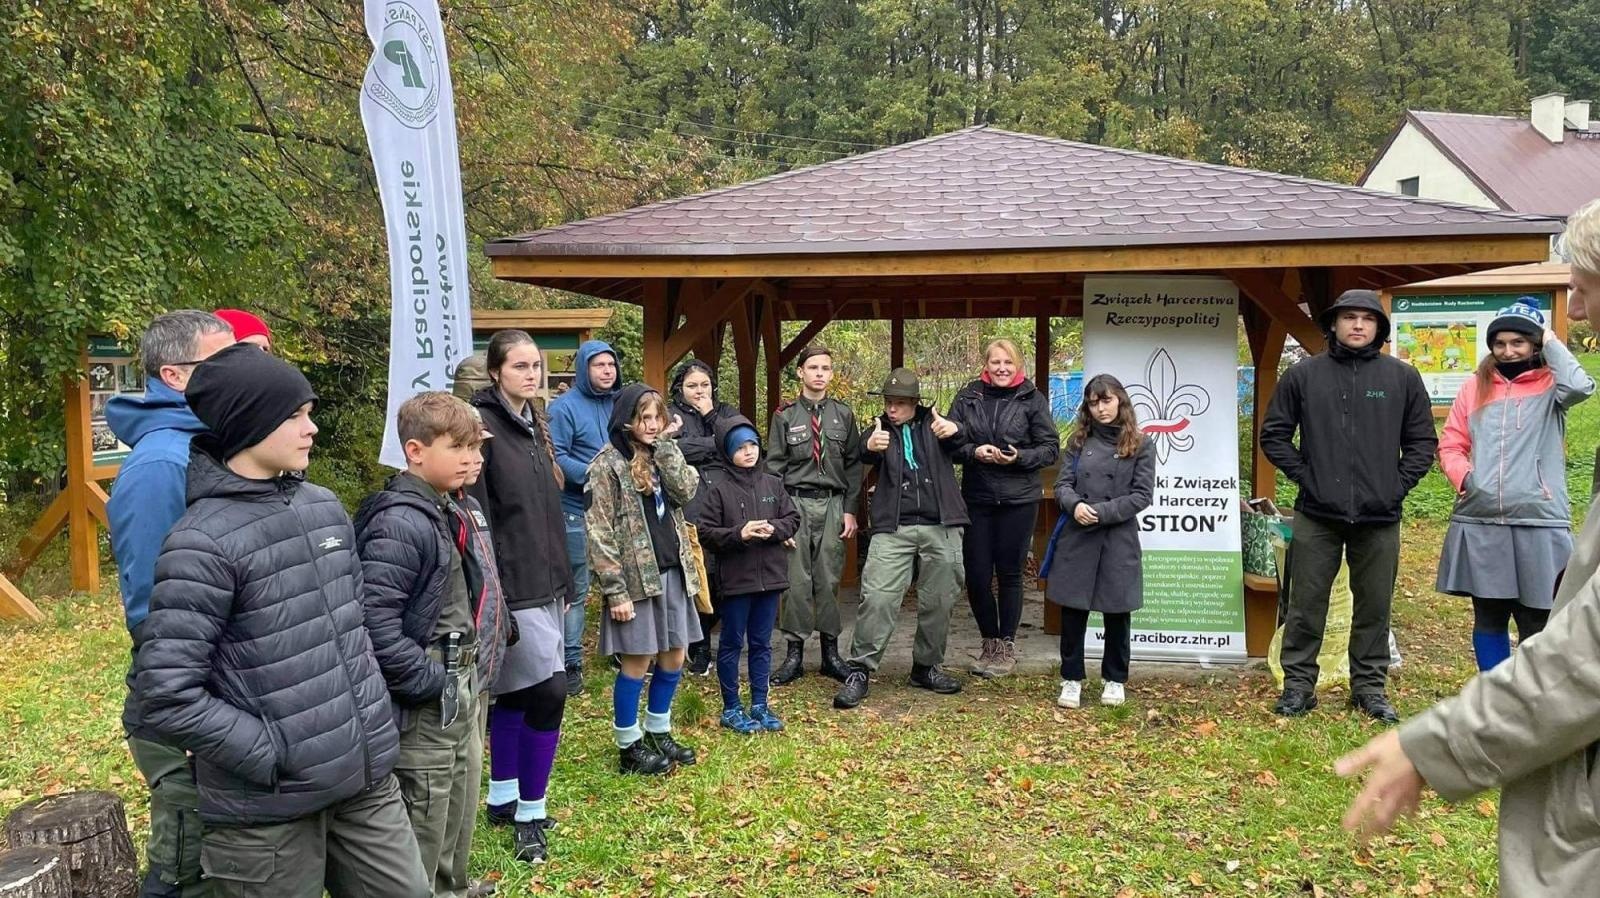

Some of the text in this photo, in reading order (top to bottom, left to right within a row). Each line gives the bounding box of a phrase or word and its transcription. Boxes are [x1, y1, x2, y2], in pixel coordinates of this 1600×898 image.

[1090, 293, 1234, 307] Związek Harcerstwa
[1106, 312, 1220, 327] Rzeczypospolitej
[1174, 476, 1237, 492] Związek
[1160, 495, 1229, 510] Harcerzy
[1137, 515, 1229, 533] STION”
[1096, 631, 1230, 648] w.raciborz.zhr.pl
